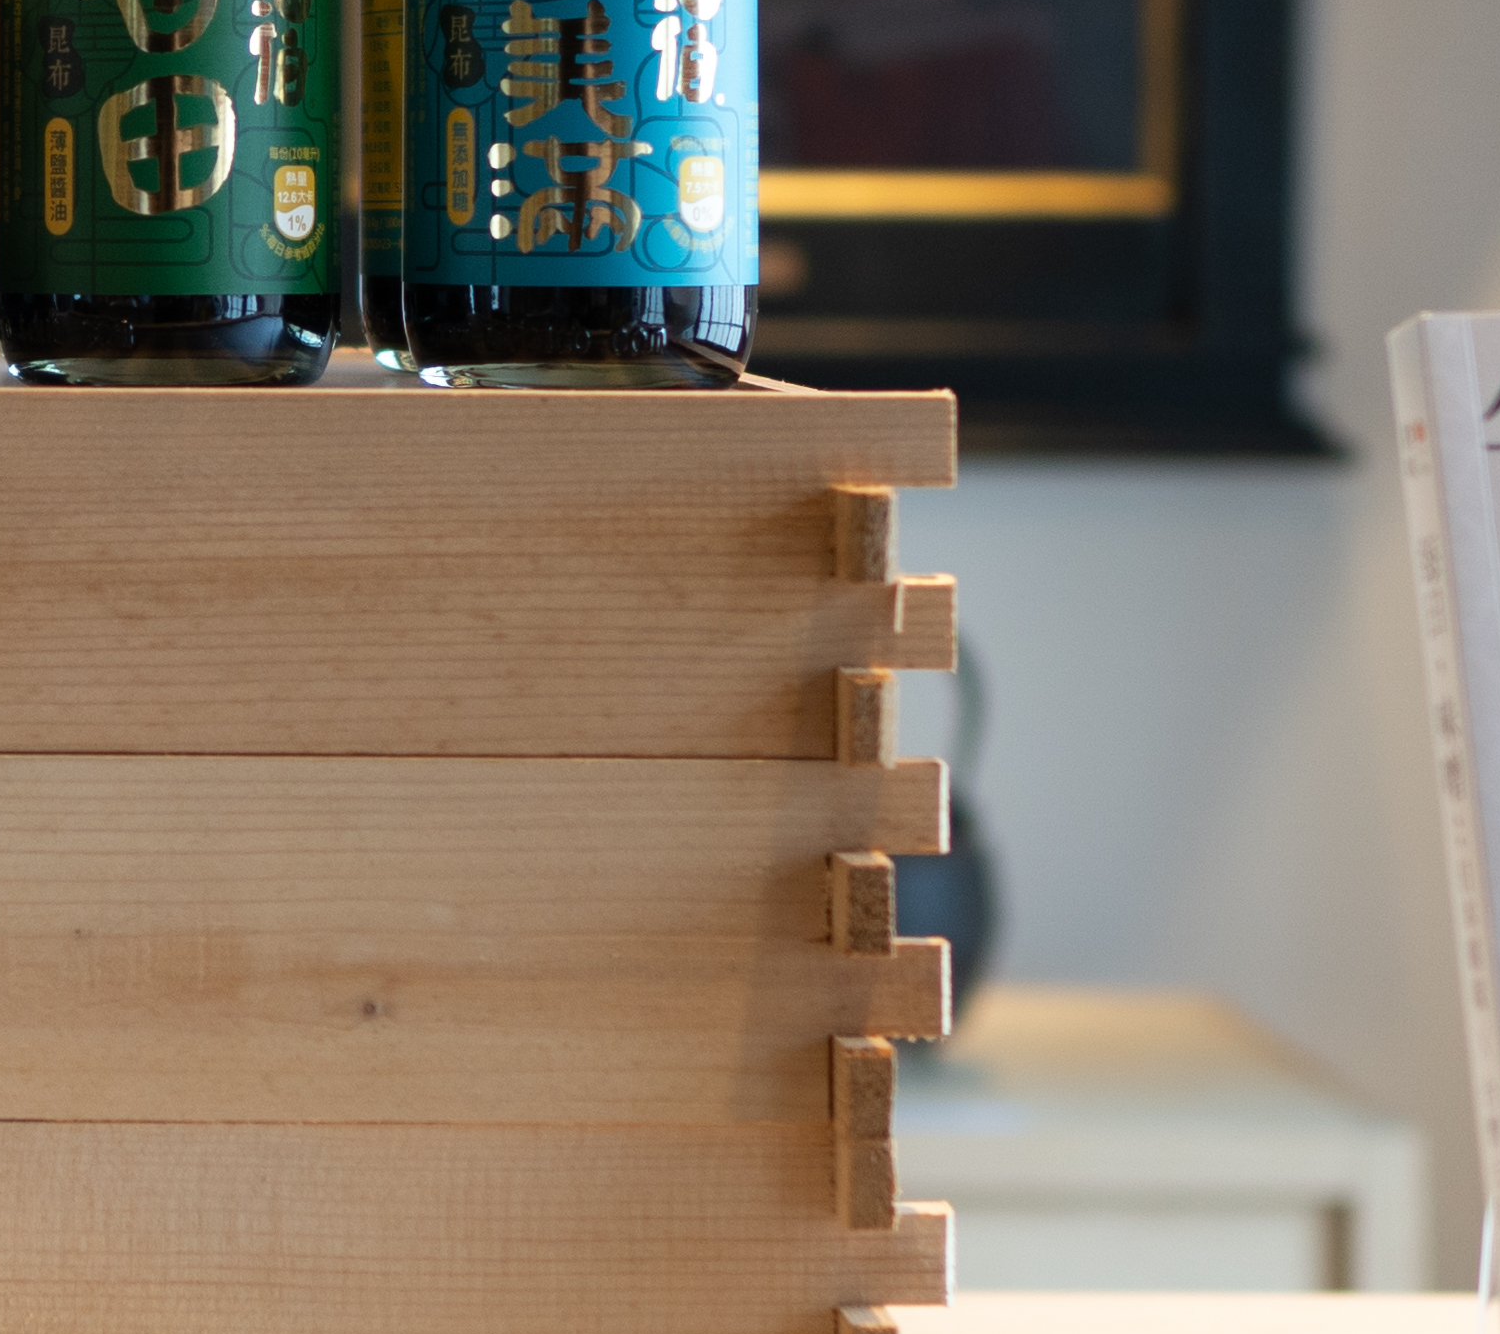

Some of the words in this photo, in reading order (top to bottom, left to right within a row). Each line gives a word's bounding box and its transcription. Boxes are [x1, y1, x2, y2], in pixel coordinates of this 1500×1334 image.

[48, 24, 73, 91] 昆布
[448, 15, 475, 81] 昆布
[49, 130, 69, 223] 薄鹽醬油
[451, 121, 470, 214] 無添加糖
[288, 214, 307, 232] 1%
